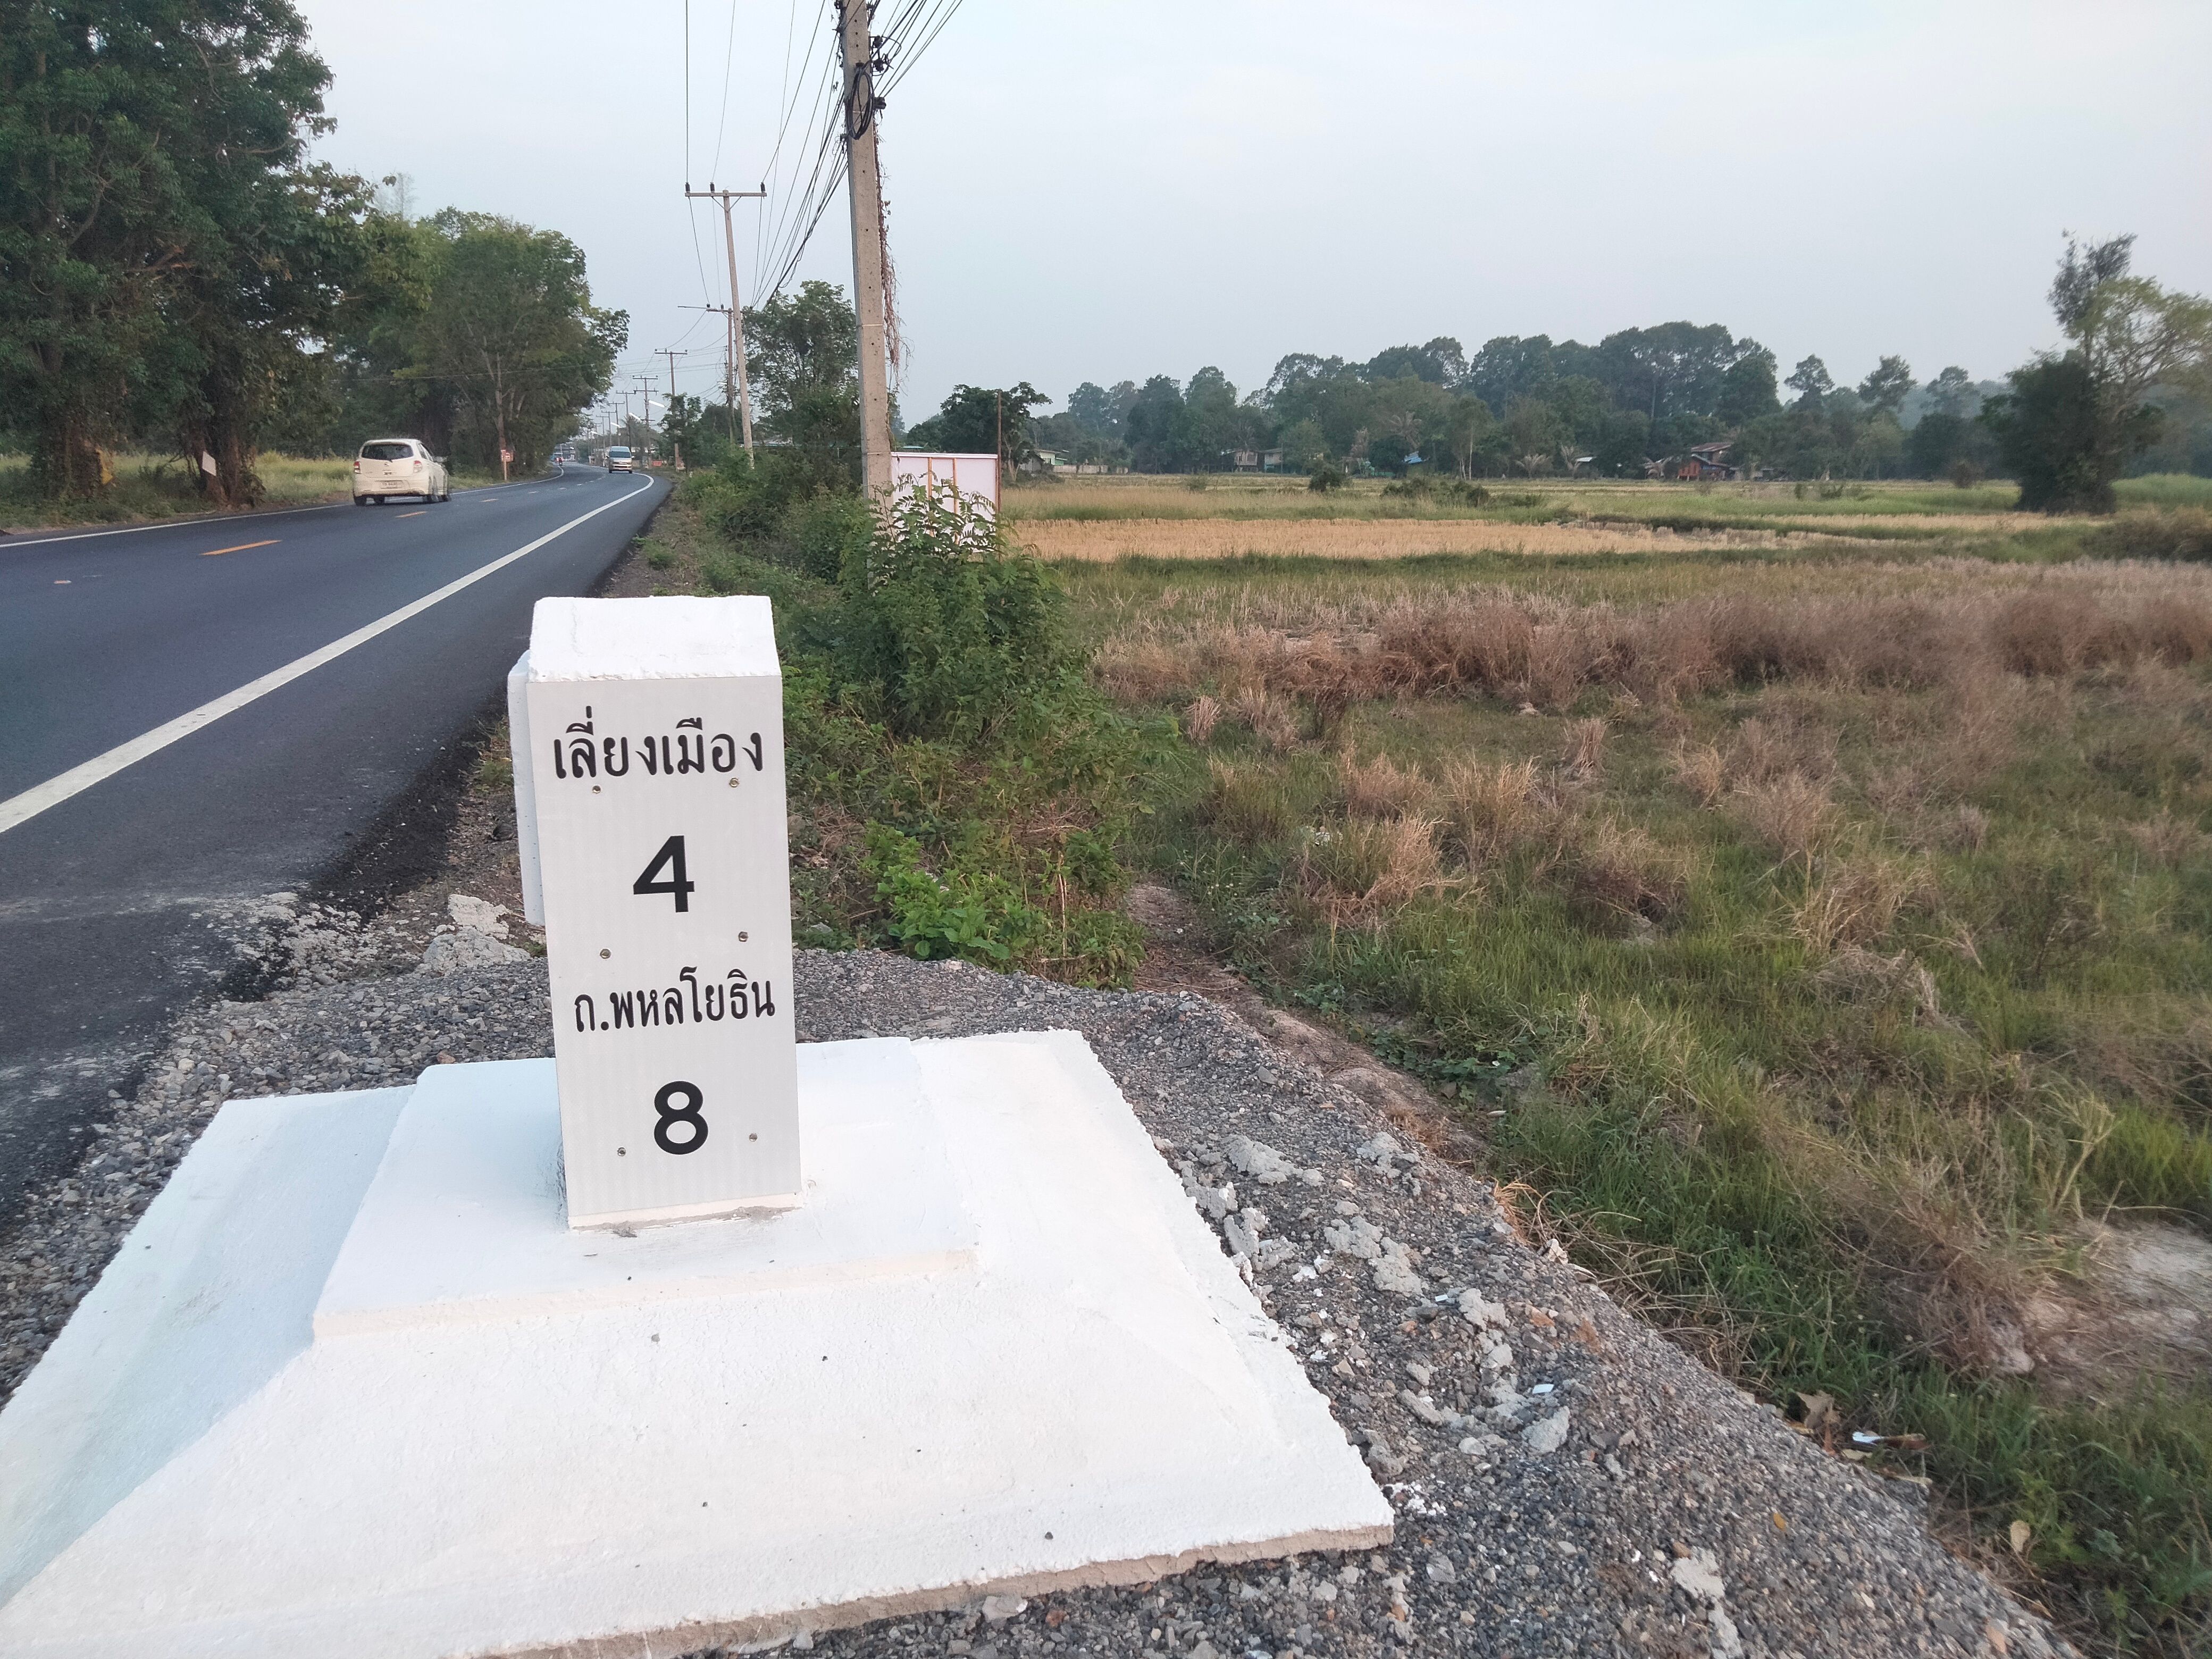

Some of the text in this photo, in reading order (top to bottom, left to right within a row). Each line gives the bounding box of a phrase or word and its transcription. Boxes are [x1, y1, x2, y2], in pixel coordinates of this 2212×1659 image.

[554, 705, 764, 779] เลี่ยงเมือง
[633, 835, 695, 913] 4
[574, 966, 775, 1033] ถ.พหลโยธิน
[653, 1080, 708, 1155] 8
